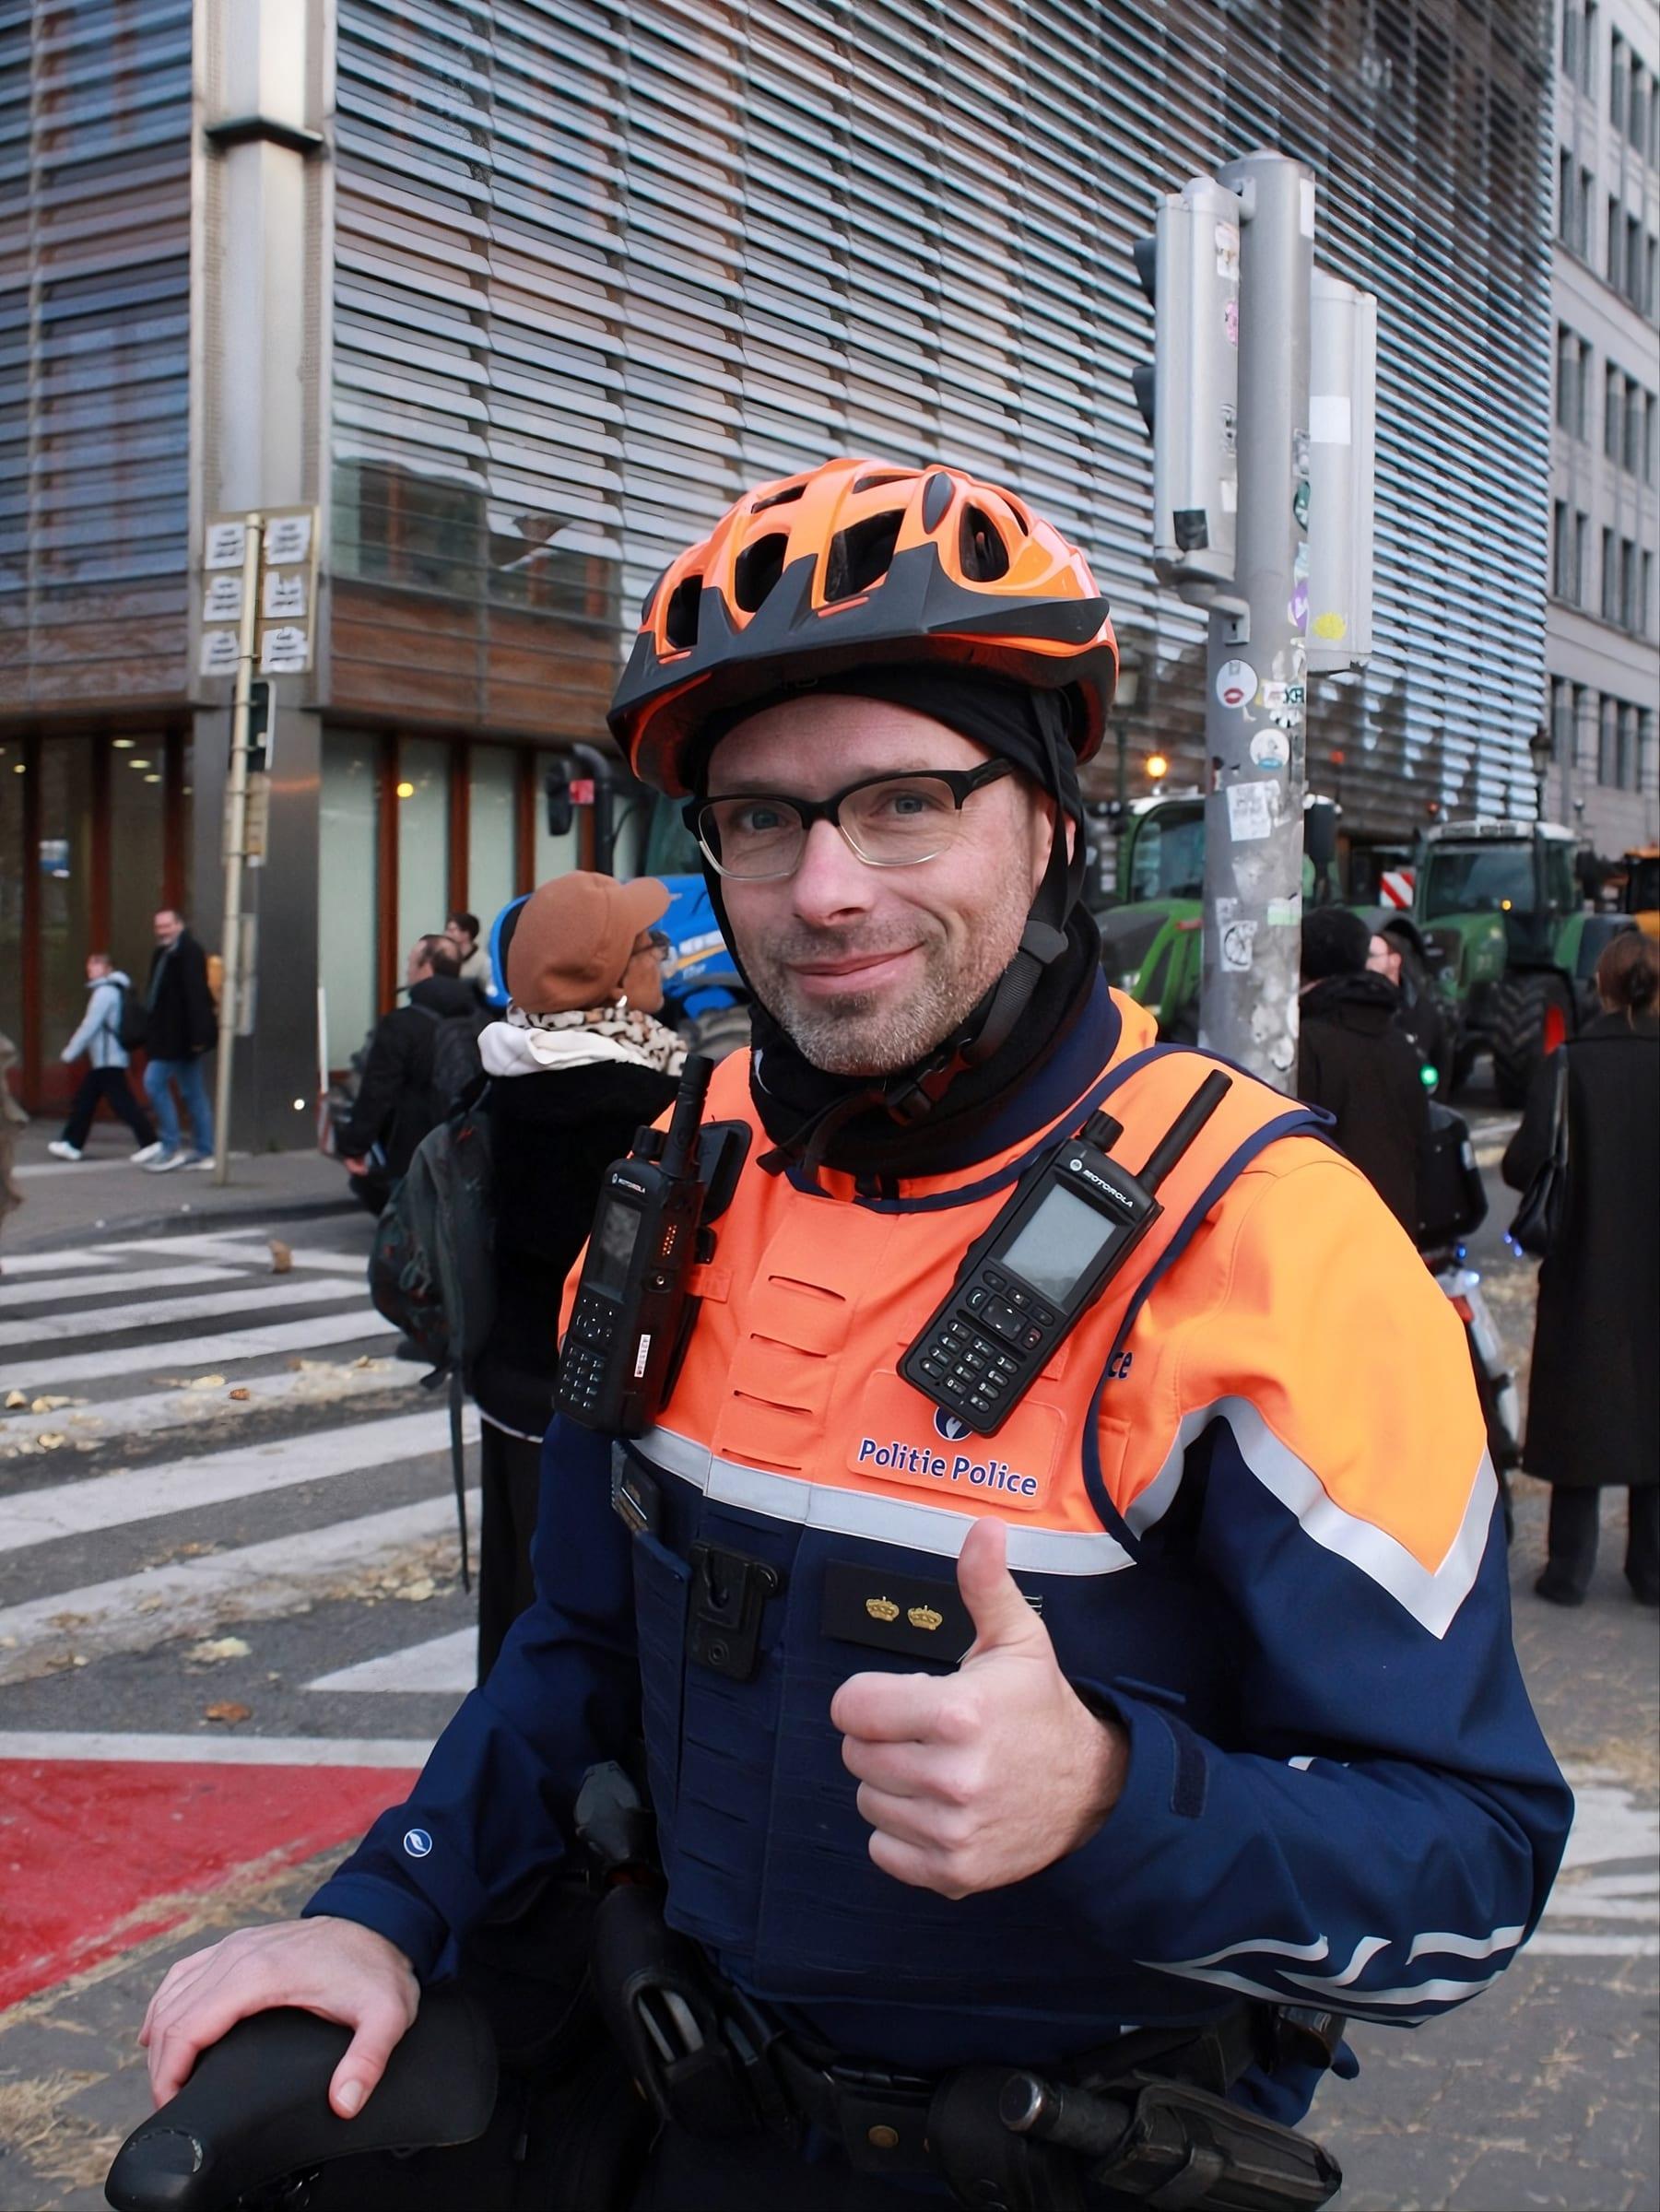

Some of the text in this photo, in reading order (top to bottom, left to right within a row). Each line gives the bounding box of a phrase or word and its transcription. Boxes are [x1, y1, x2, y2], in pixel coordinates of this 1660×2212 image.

[1082, 1169, 1134, 1207] MOTOROLA
[859, 1439, 1037, 1495] Politie Police
